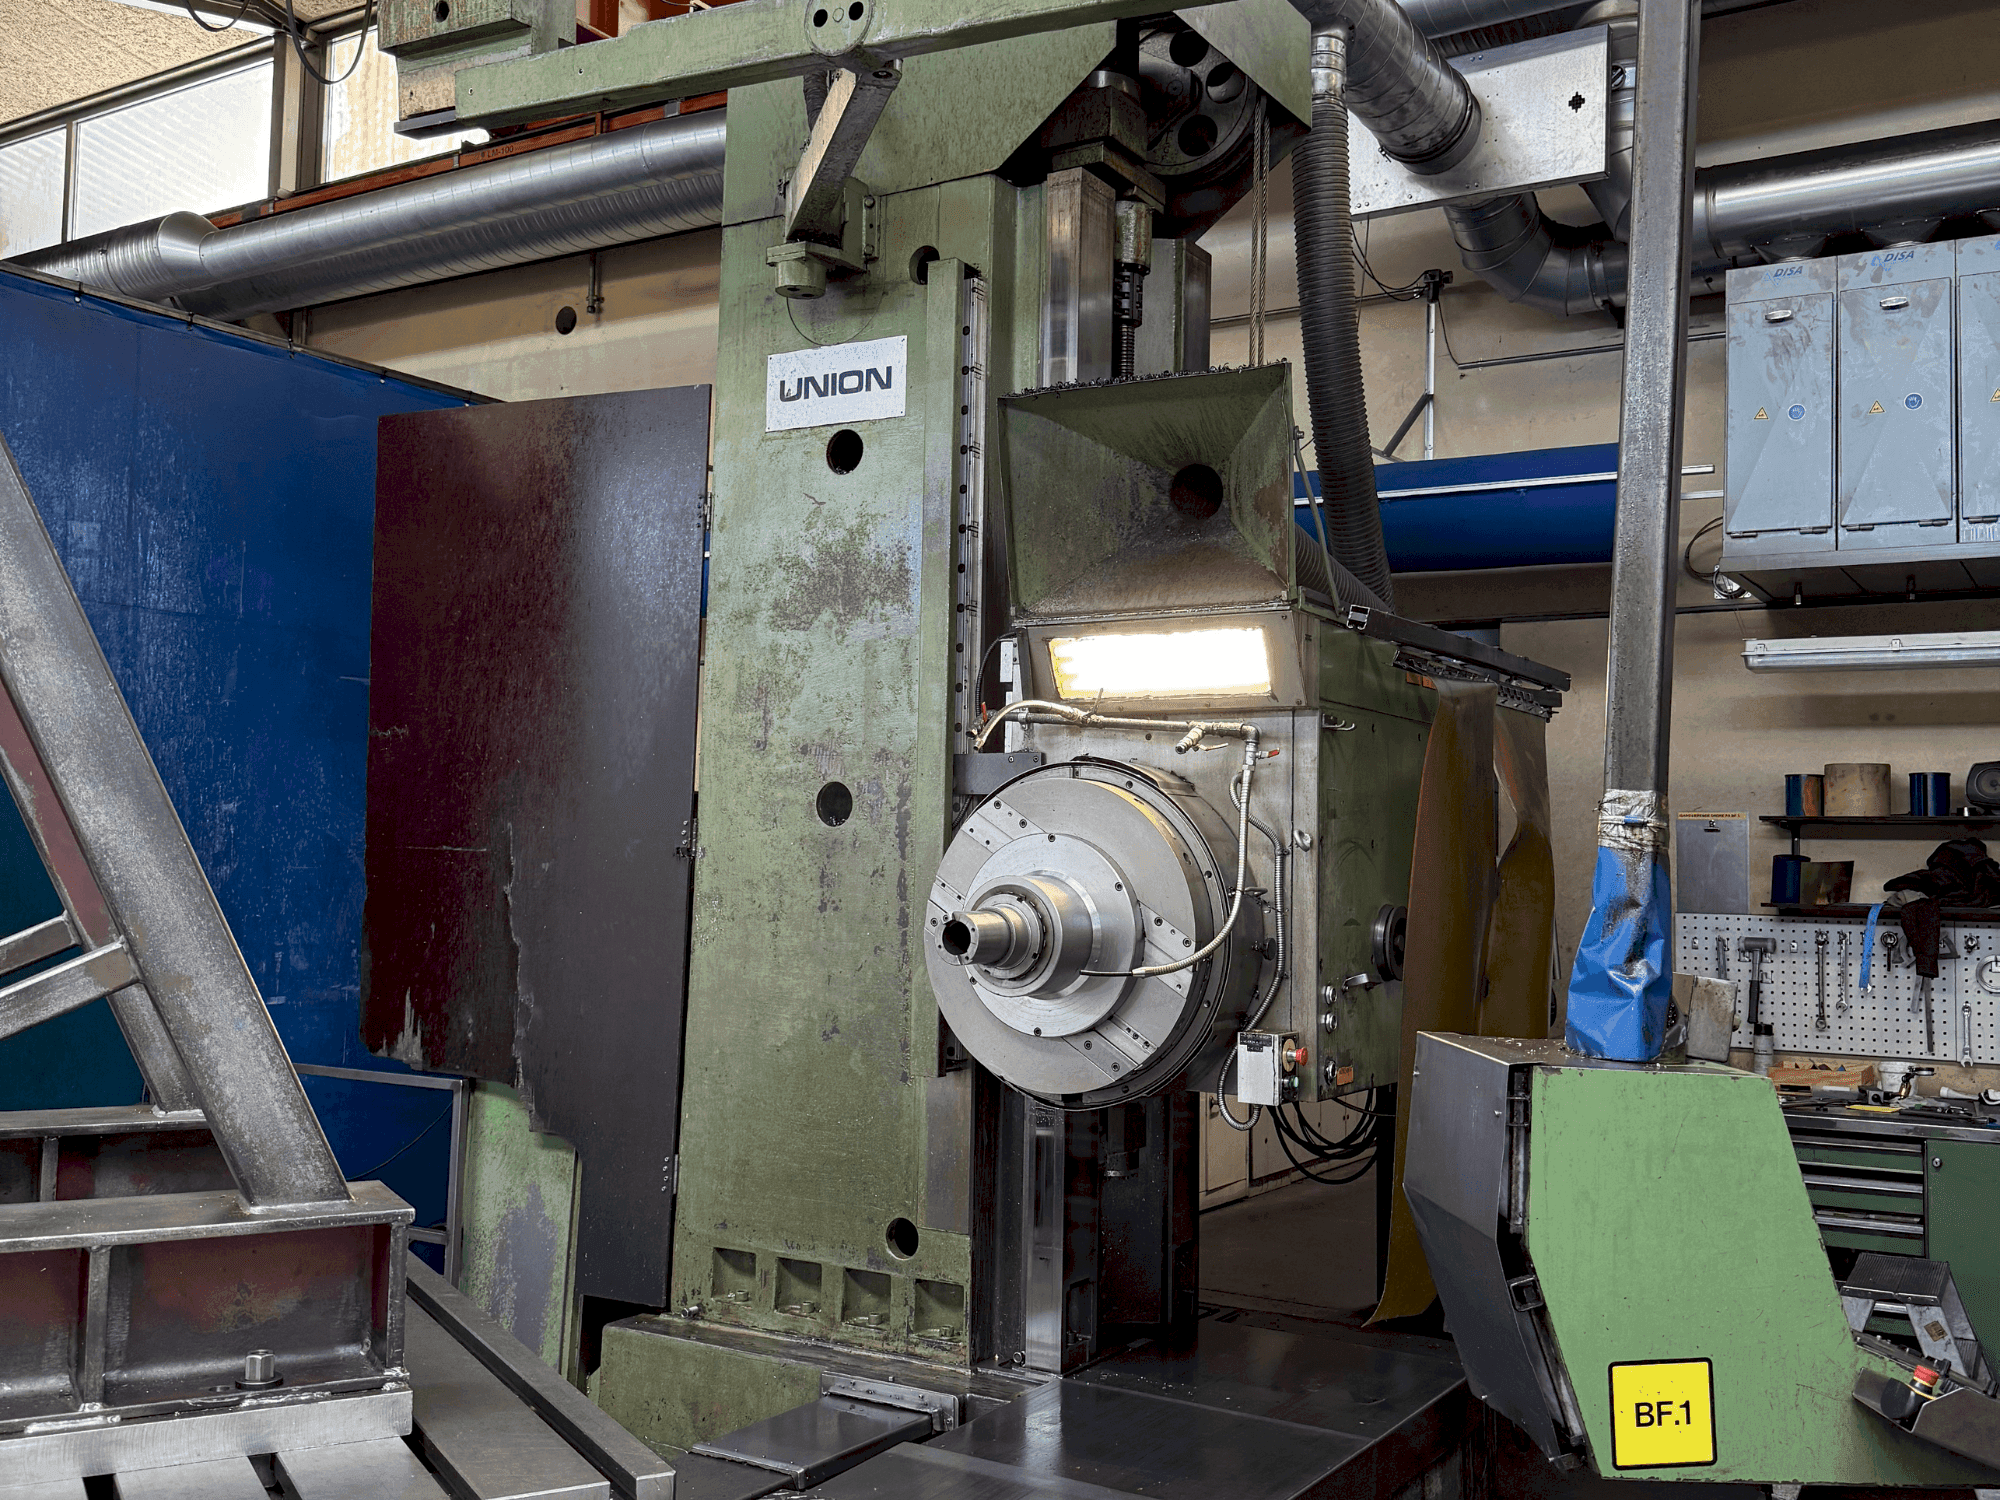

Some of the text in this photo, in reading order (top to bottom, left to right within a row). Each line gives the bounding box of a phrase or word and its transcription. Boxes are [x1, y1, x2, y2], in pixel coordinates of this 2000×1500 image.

[1884, 250, 1915, 263] DISA
[1773, 266, 1803, 277] DISA
[780, 366, 892, 402] UNION
[1634, 1400, 1691, 1428] BF.1
